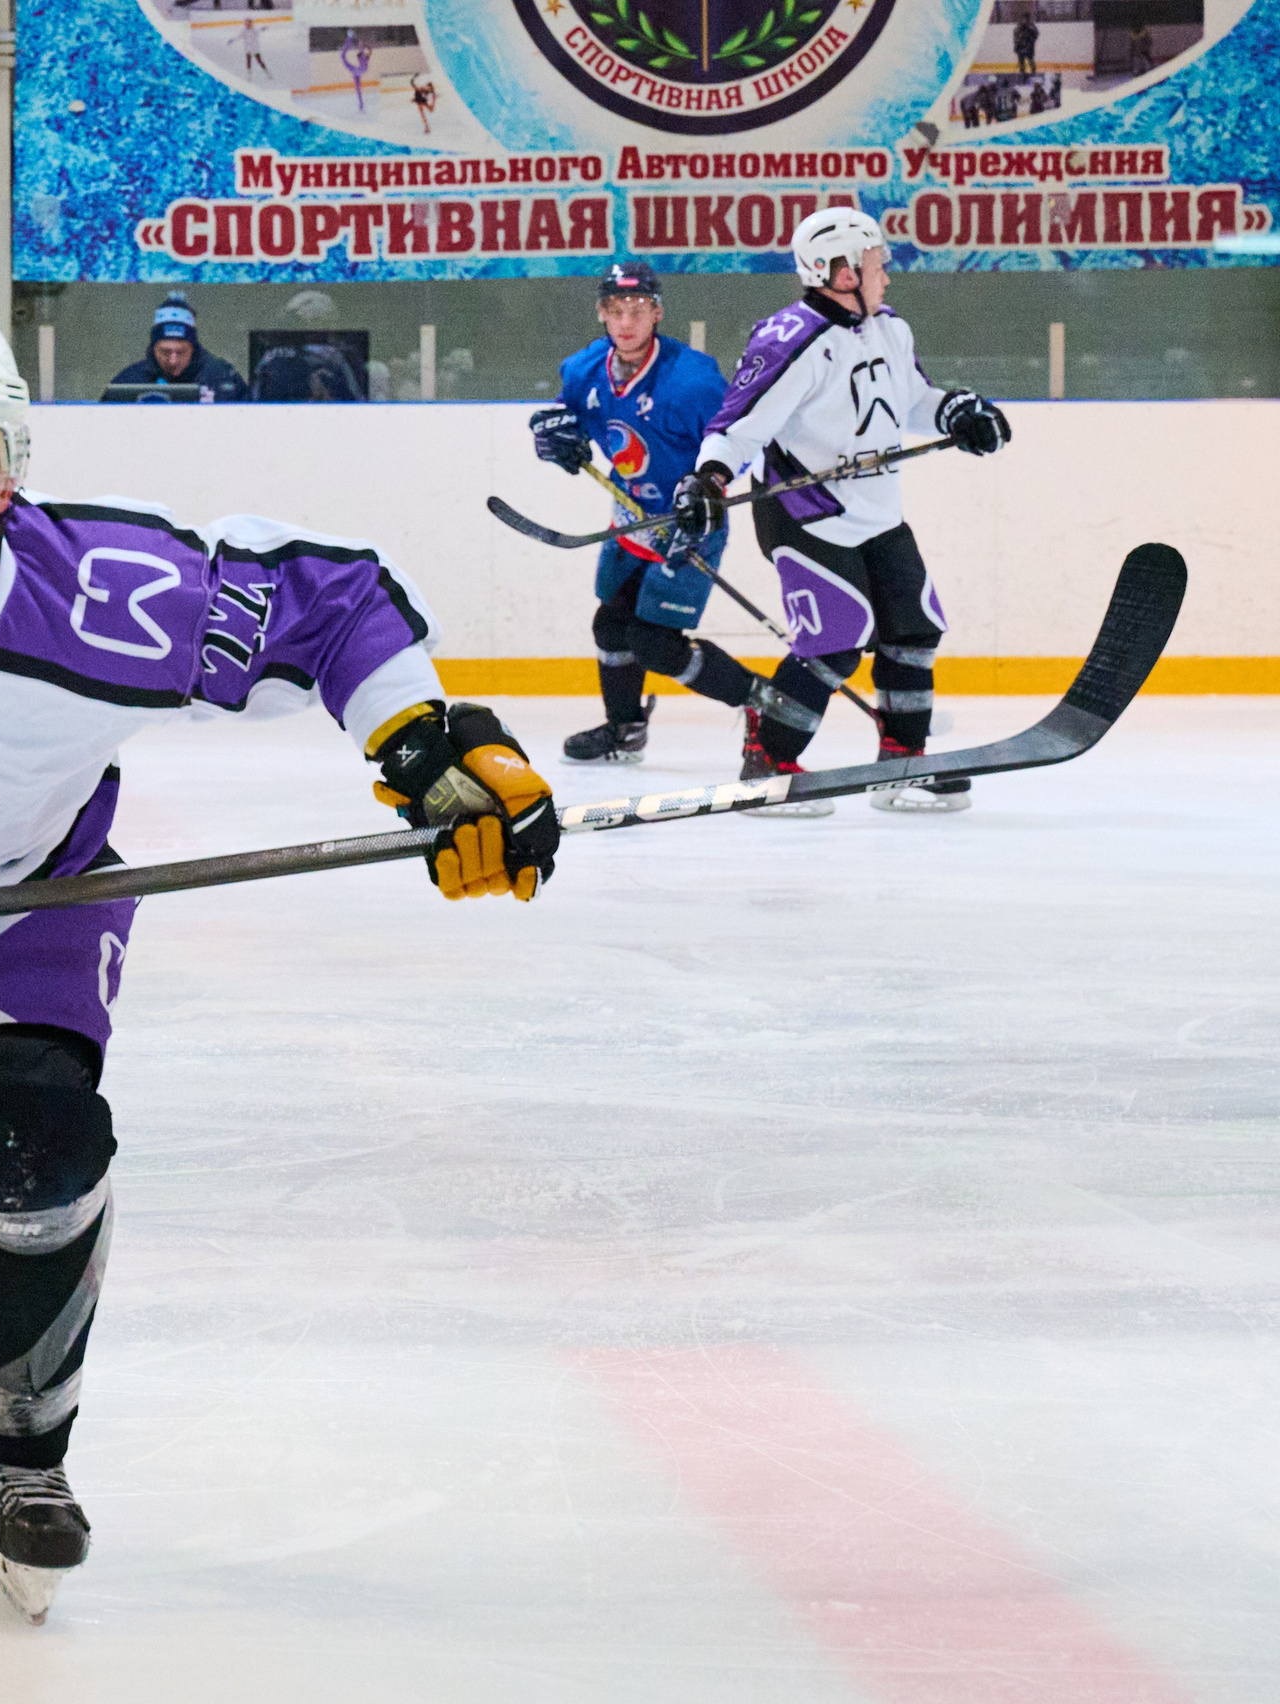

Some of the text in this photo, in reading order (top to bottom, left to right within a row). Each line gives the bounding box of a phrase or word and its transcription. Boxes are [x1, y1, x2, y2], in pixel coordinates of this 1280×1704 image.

[564, 25, 849, 111] СПОРТИВНАЯ ШКОЛА
[240, 154, 602, 197] Муниципального
[617, 145, 888, 180] Автономного
[141, 189, 1267, 257] «СПОРТИВНАЯ ШКОЛ «ОЛИМПИЯ»
